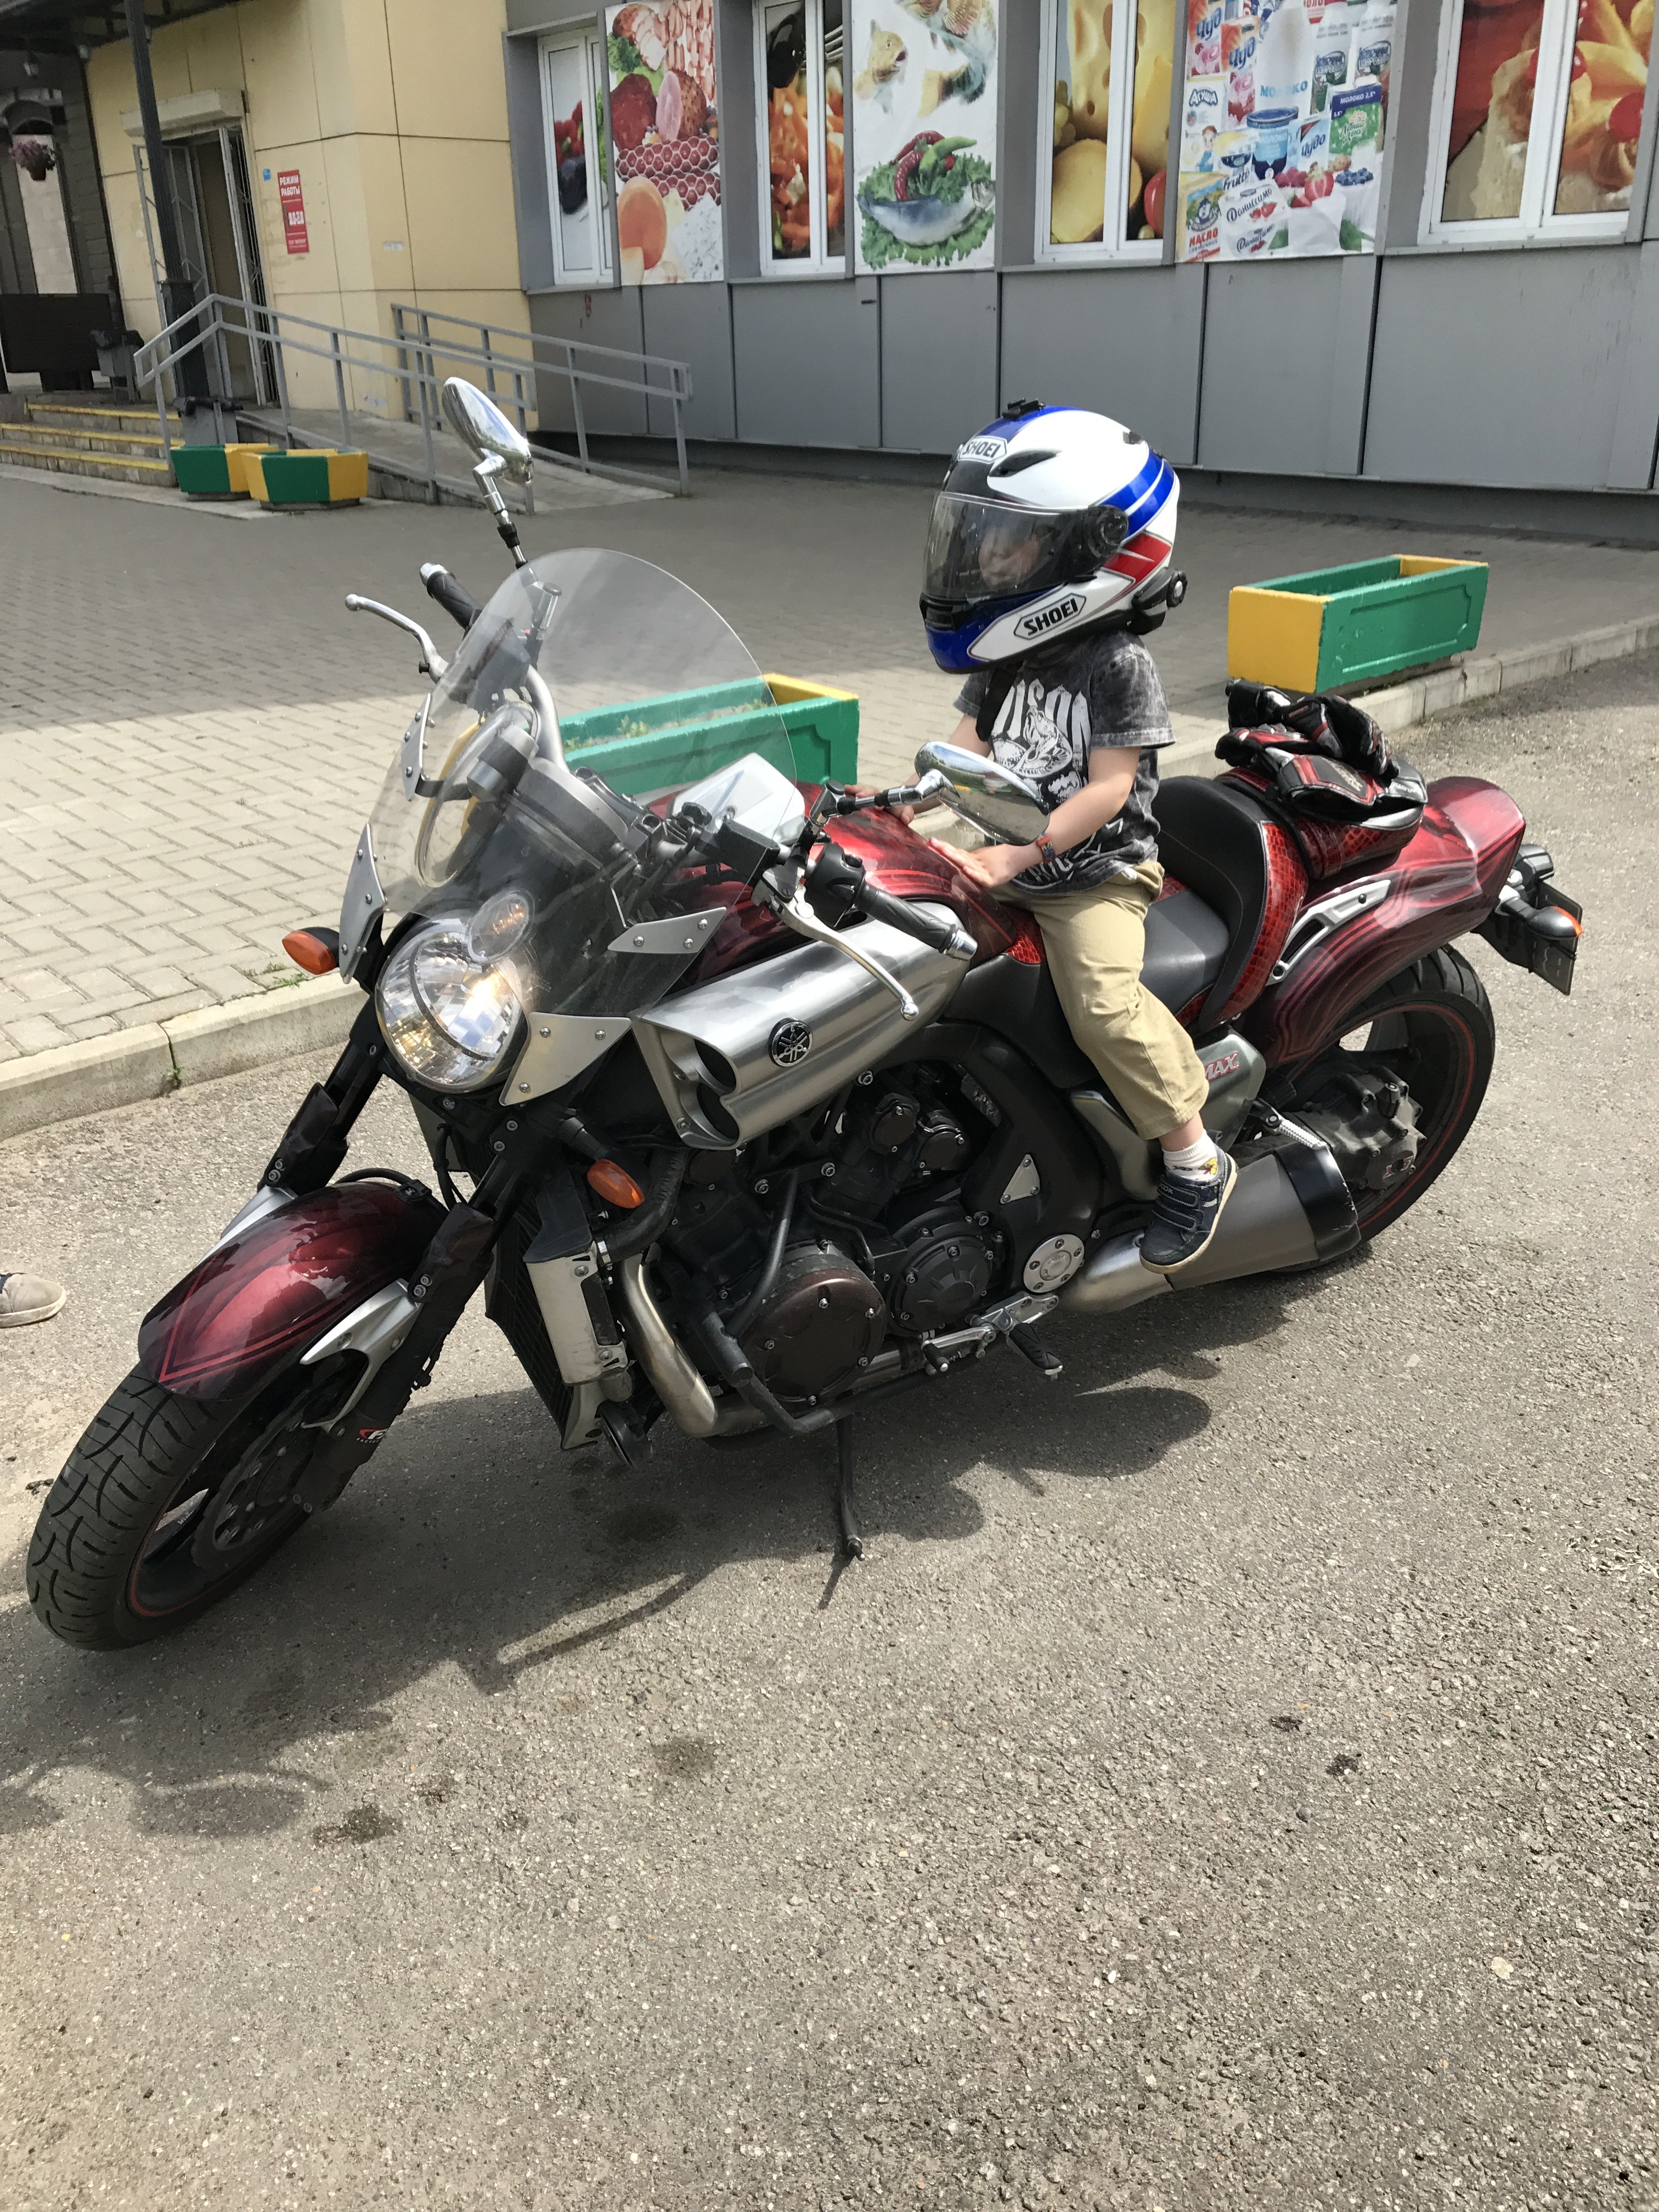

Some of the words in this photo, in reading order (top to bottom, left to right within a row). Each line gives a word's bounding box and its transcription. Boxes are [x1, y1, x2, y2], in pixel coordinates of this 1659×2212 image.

[1340, 93, 1364, 104] МОЛОКО
[279, 174, 299, 186] РЕЖИМ
[281, 185, 301, 196] РАБОТЫ
[962, 441, 1002, 458] SHOEI
[1023, 597, 1079, 636] SHOEI
